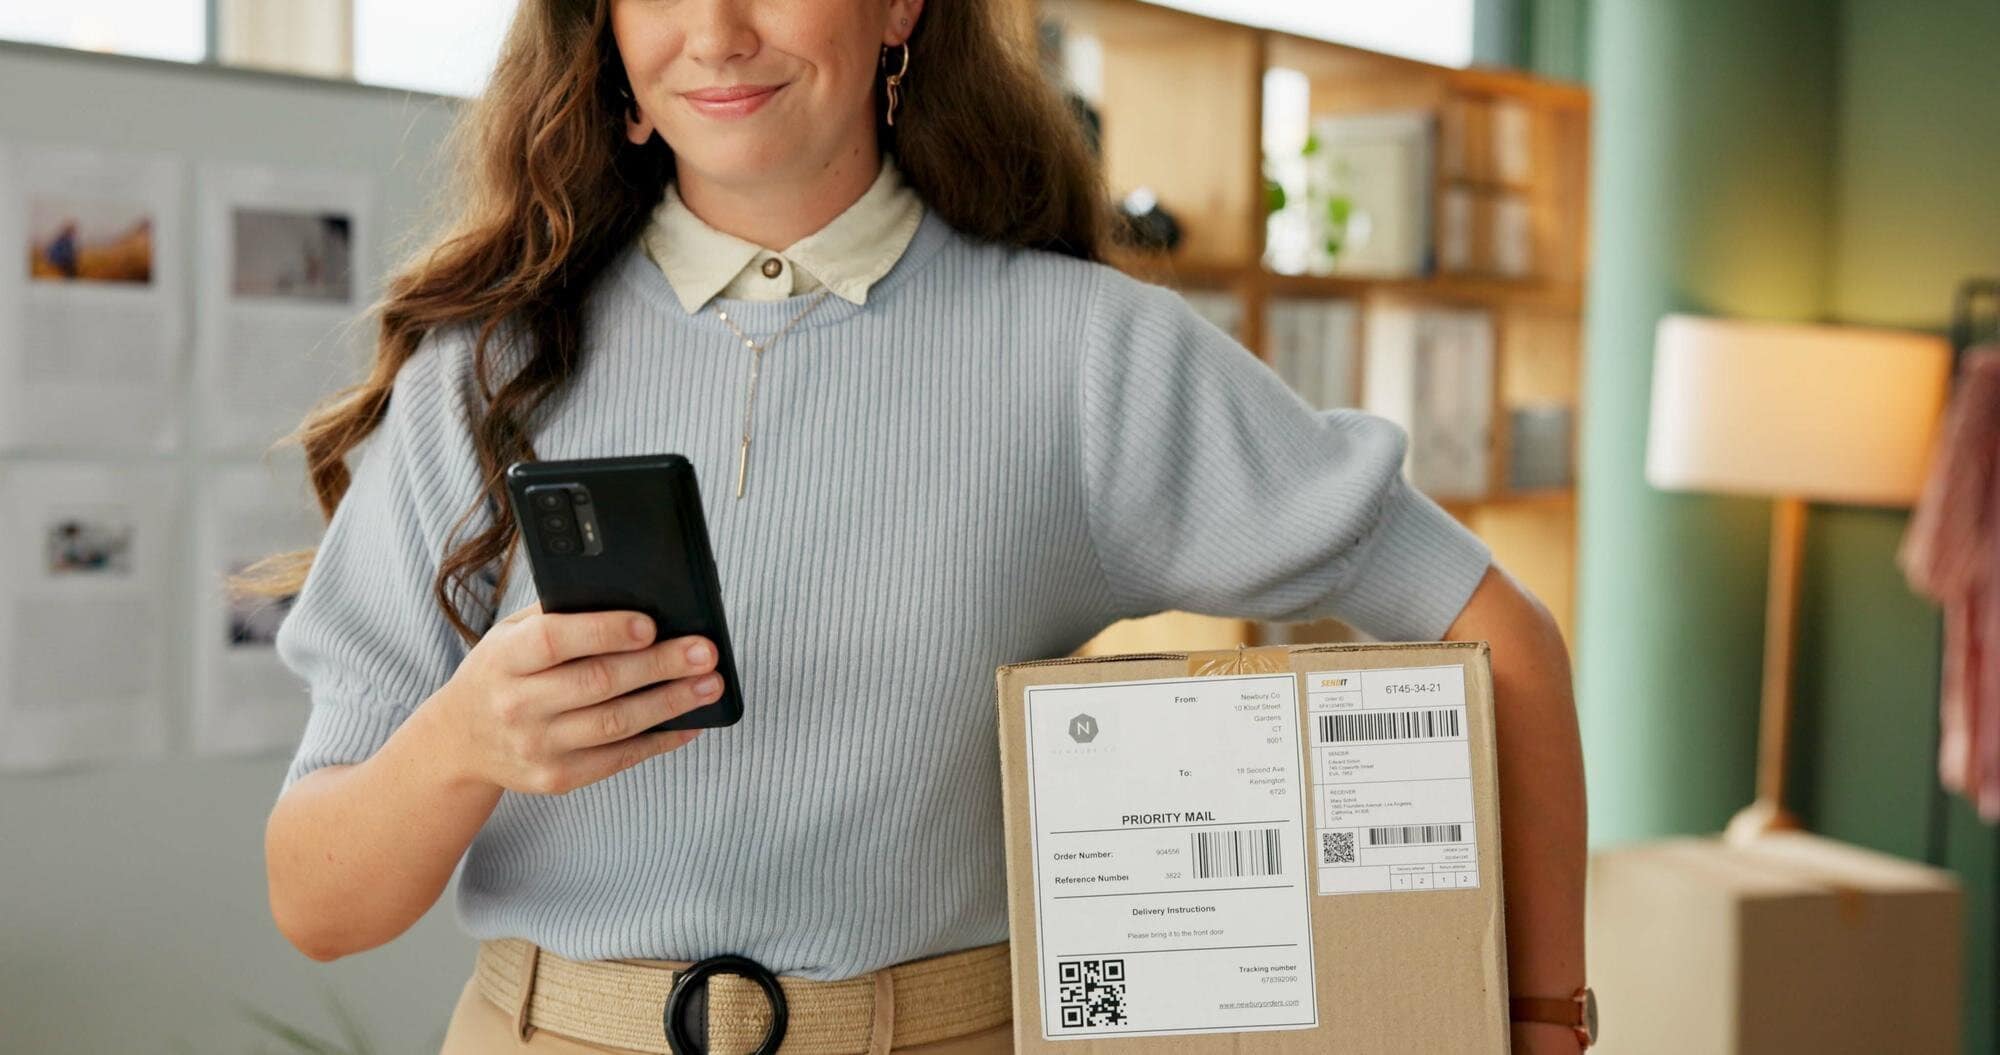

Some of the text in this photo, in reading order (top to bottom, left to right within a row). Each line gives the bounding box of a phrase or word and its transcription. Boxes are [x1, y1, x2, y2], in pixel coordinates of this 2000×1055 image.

[1385, 683, 1441, 694] 6T45-34-21
[1174, 696, 1198, 704] From:
[1240, 693, 1269, 701] Newbury
[1179, 769, 1192, 777] To:
[1249, 777, 1285, 785] Kensington
[1122, 811, 1216, 825] PRIORITY MAIL
[1053, 851, 1114, 861] Order Number:
[1055, 876, 1096, 885] Reference
[1132, 905, 1216, 916] Delivery Instructions
